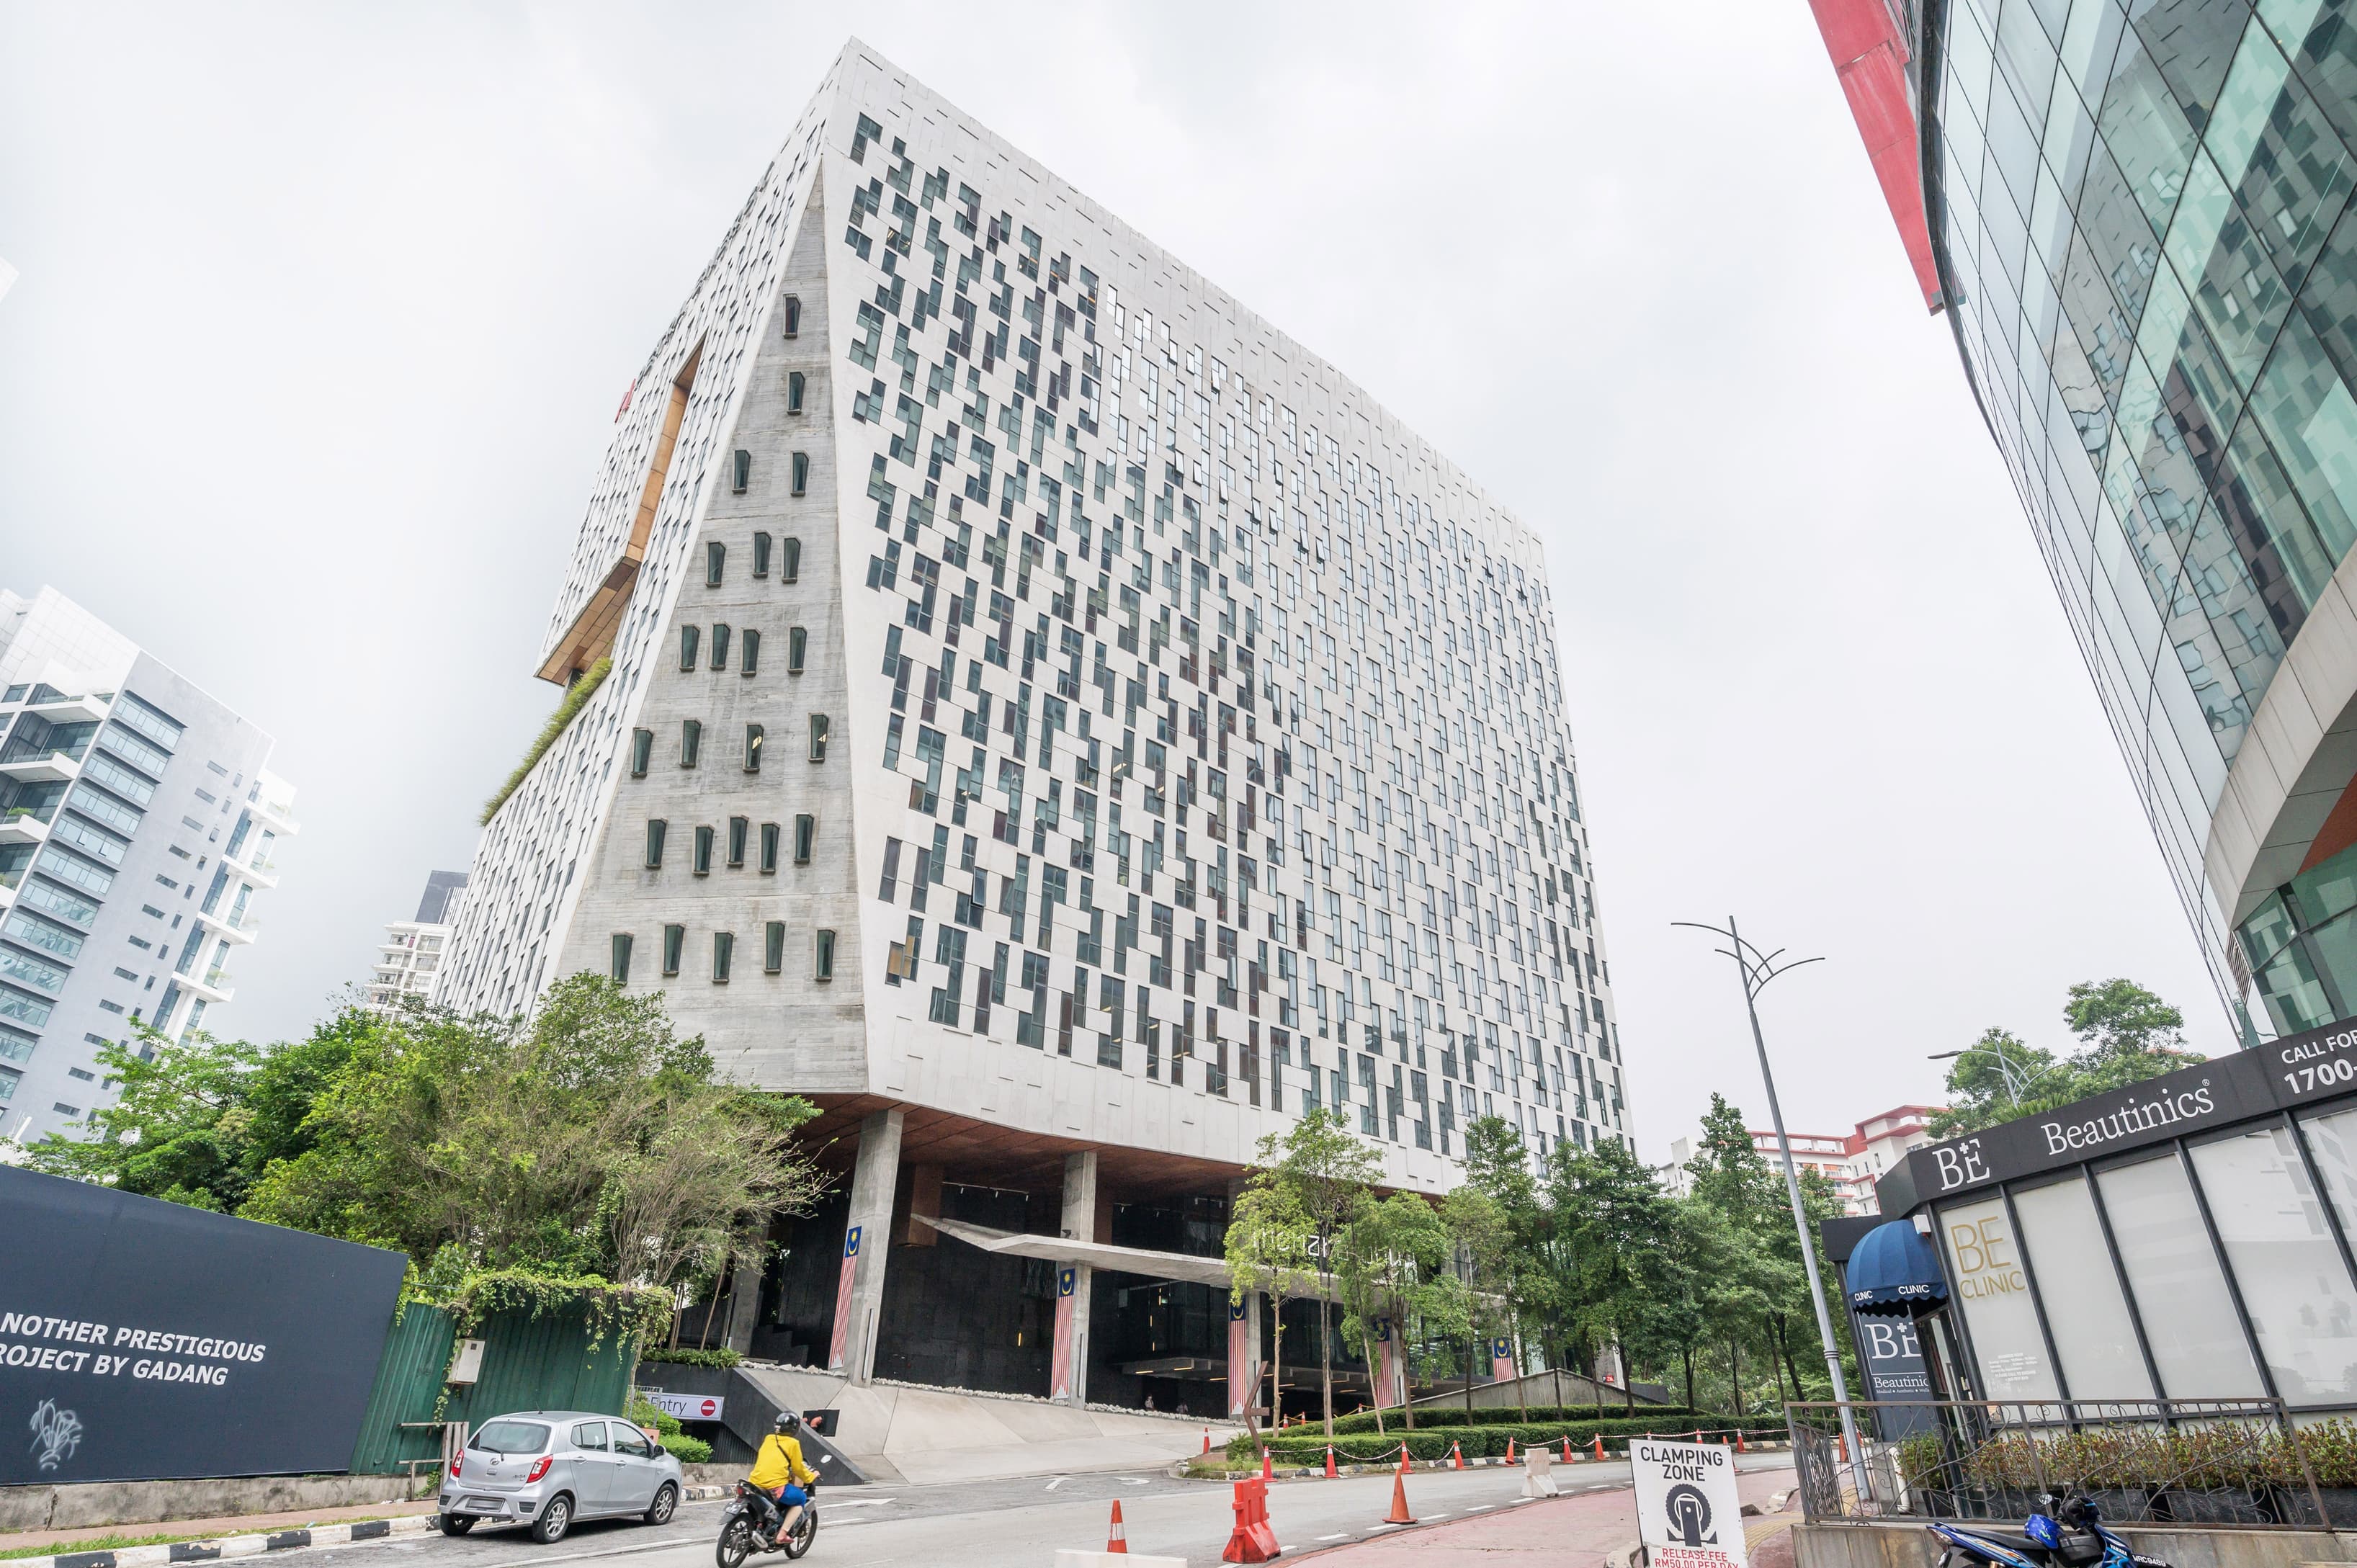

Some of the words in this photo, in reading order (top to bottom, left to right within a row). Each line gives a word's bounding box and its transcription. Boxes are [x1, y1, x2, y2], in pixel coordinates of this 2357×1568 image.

[2281, 1041, 2326, 1064] CALL
[1950, 1216, 2011, 1274] BE
[1898, 1284, 1930, 1295] CLINIC
[1959, 1271, 2026, 1299] CLINIC
[1854, 1290, 1873, 1302] CLINIC
[113, 1327, 266, 1362] PRESTIGIOUS
[92, 1355, 129, 1376] BY
[133, 1359, 228, 1385] GADANG
[1640, 1446, 1723, 1466] CLAMPING
[1662, 1464, 1705, 1482] ZONE
[1662, 1548, 1707, 1560] RELEASE
[1709, 1551, 1727, 1562] FEE
[2110, 1544, 2128, 1556] YAMAHA
